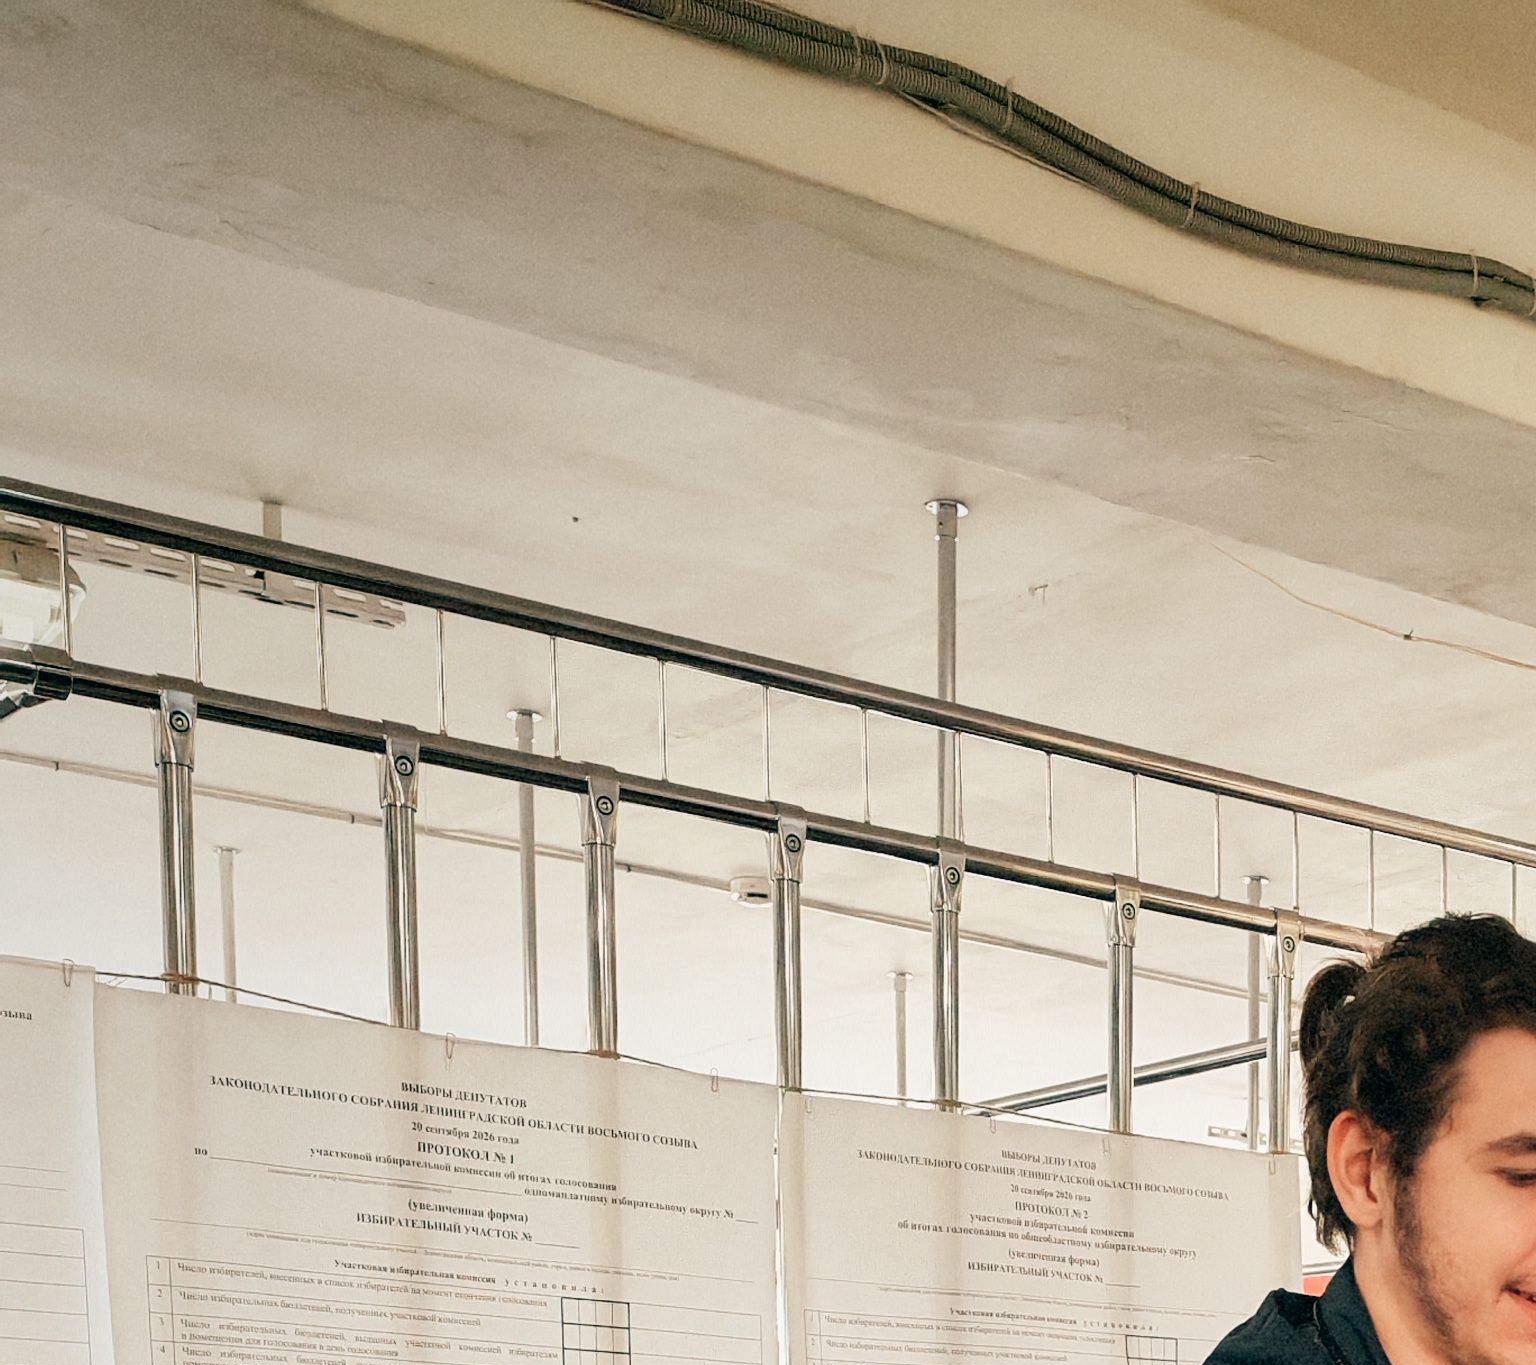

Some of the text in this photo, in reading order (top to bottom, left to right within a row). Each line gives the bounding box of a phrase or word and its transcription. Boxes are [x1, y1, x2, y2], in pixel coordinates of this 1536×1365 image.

[0, 1010, 32, 1020] зыва
[401, 1083, 527, 1108] ВЫБОРЫ ДЕПУТАТОВ
[209, 1077, 698, 1149] ЗАКОНОДАТЕЛЬНОГО СОБРАНИЯ ЛЕНИНГРАДСКОЙ ОБЛАСТИ ВОСЬМОГО СОЗЫВА
[411, 1122, 519, 1145] 20 сентября 2026 года
[194, 1147, 208, 1155] по
[417, 1142, 514, 1164] ПРОТОКОЛ № 1
[1001, 1150, 1097, 1169] ВЫБОРЫ ДЕПУТАТОВ
[310, 1148, 371, 1162] участковой
[376, 1155, 450, 1171] избирательной
[454, 1164, 500, 1177] комиссии
[504, 1169, 515, 1179] об
[555, 1176, 617, 1190] голосования
[856, 1150, 962, 1171] ЗАКОНОДАТЕЛЬНОГО
[964, 1162, 1016, 1177] СОБРАНИЯ
[1097, 1176, 1142, 1190] ОБЛАСТИ
[1144, 1182, 1193, 1196] ВОСЬМОГО
[1195, 1187, 1229, 1200] СОЗЫВА
[408, 1199, 528, 1224] (увеличенная форма)
[524, 1189, 608, 1207] одномандатному
[611, 1197, 686, 1215] избирательному
[723, 1209, 734, 1218] №
[1015, 1201, 1069, 1217] ПРОТОКОЛ
[1082, 1208, 1089, 1219] 2
[356, 1213, 532, 1240] ИЗБИРАТЕЛЬНЫЙ УЧАСТОК №
[946, 1226, 1006, 1238] голосования
